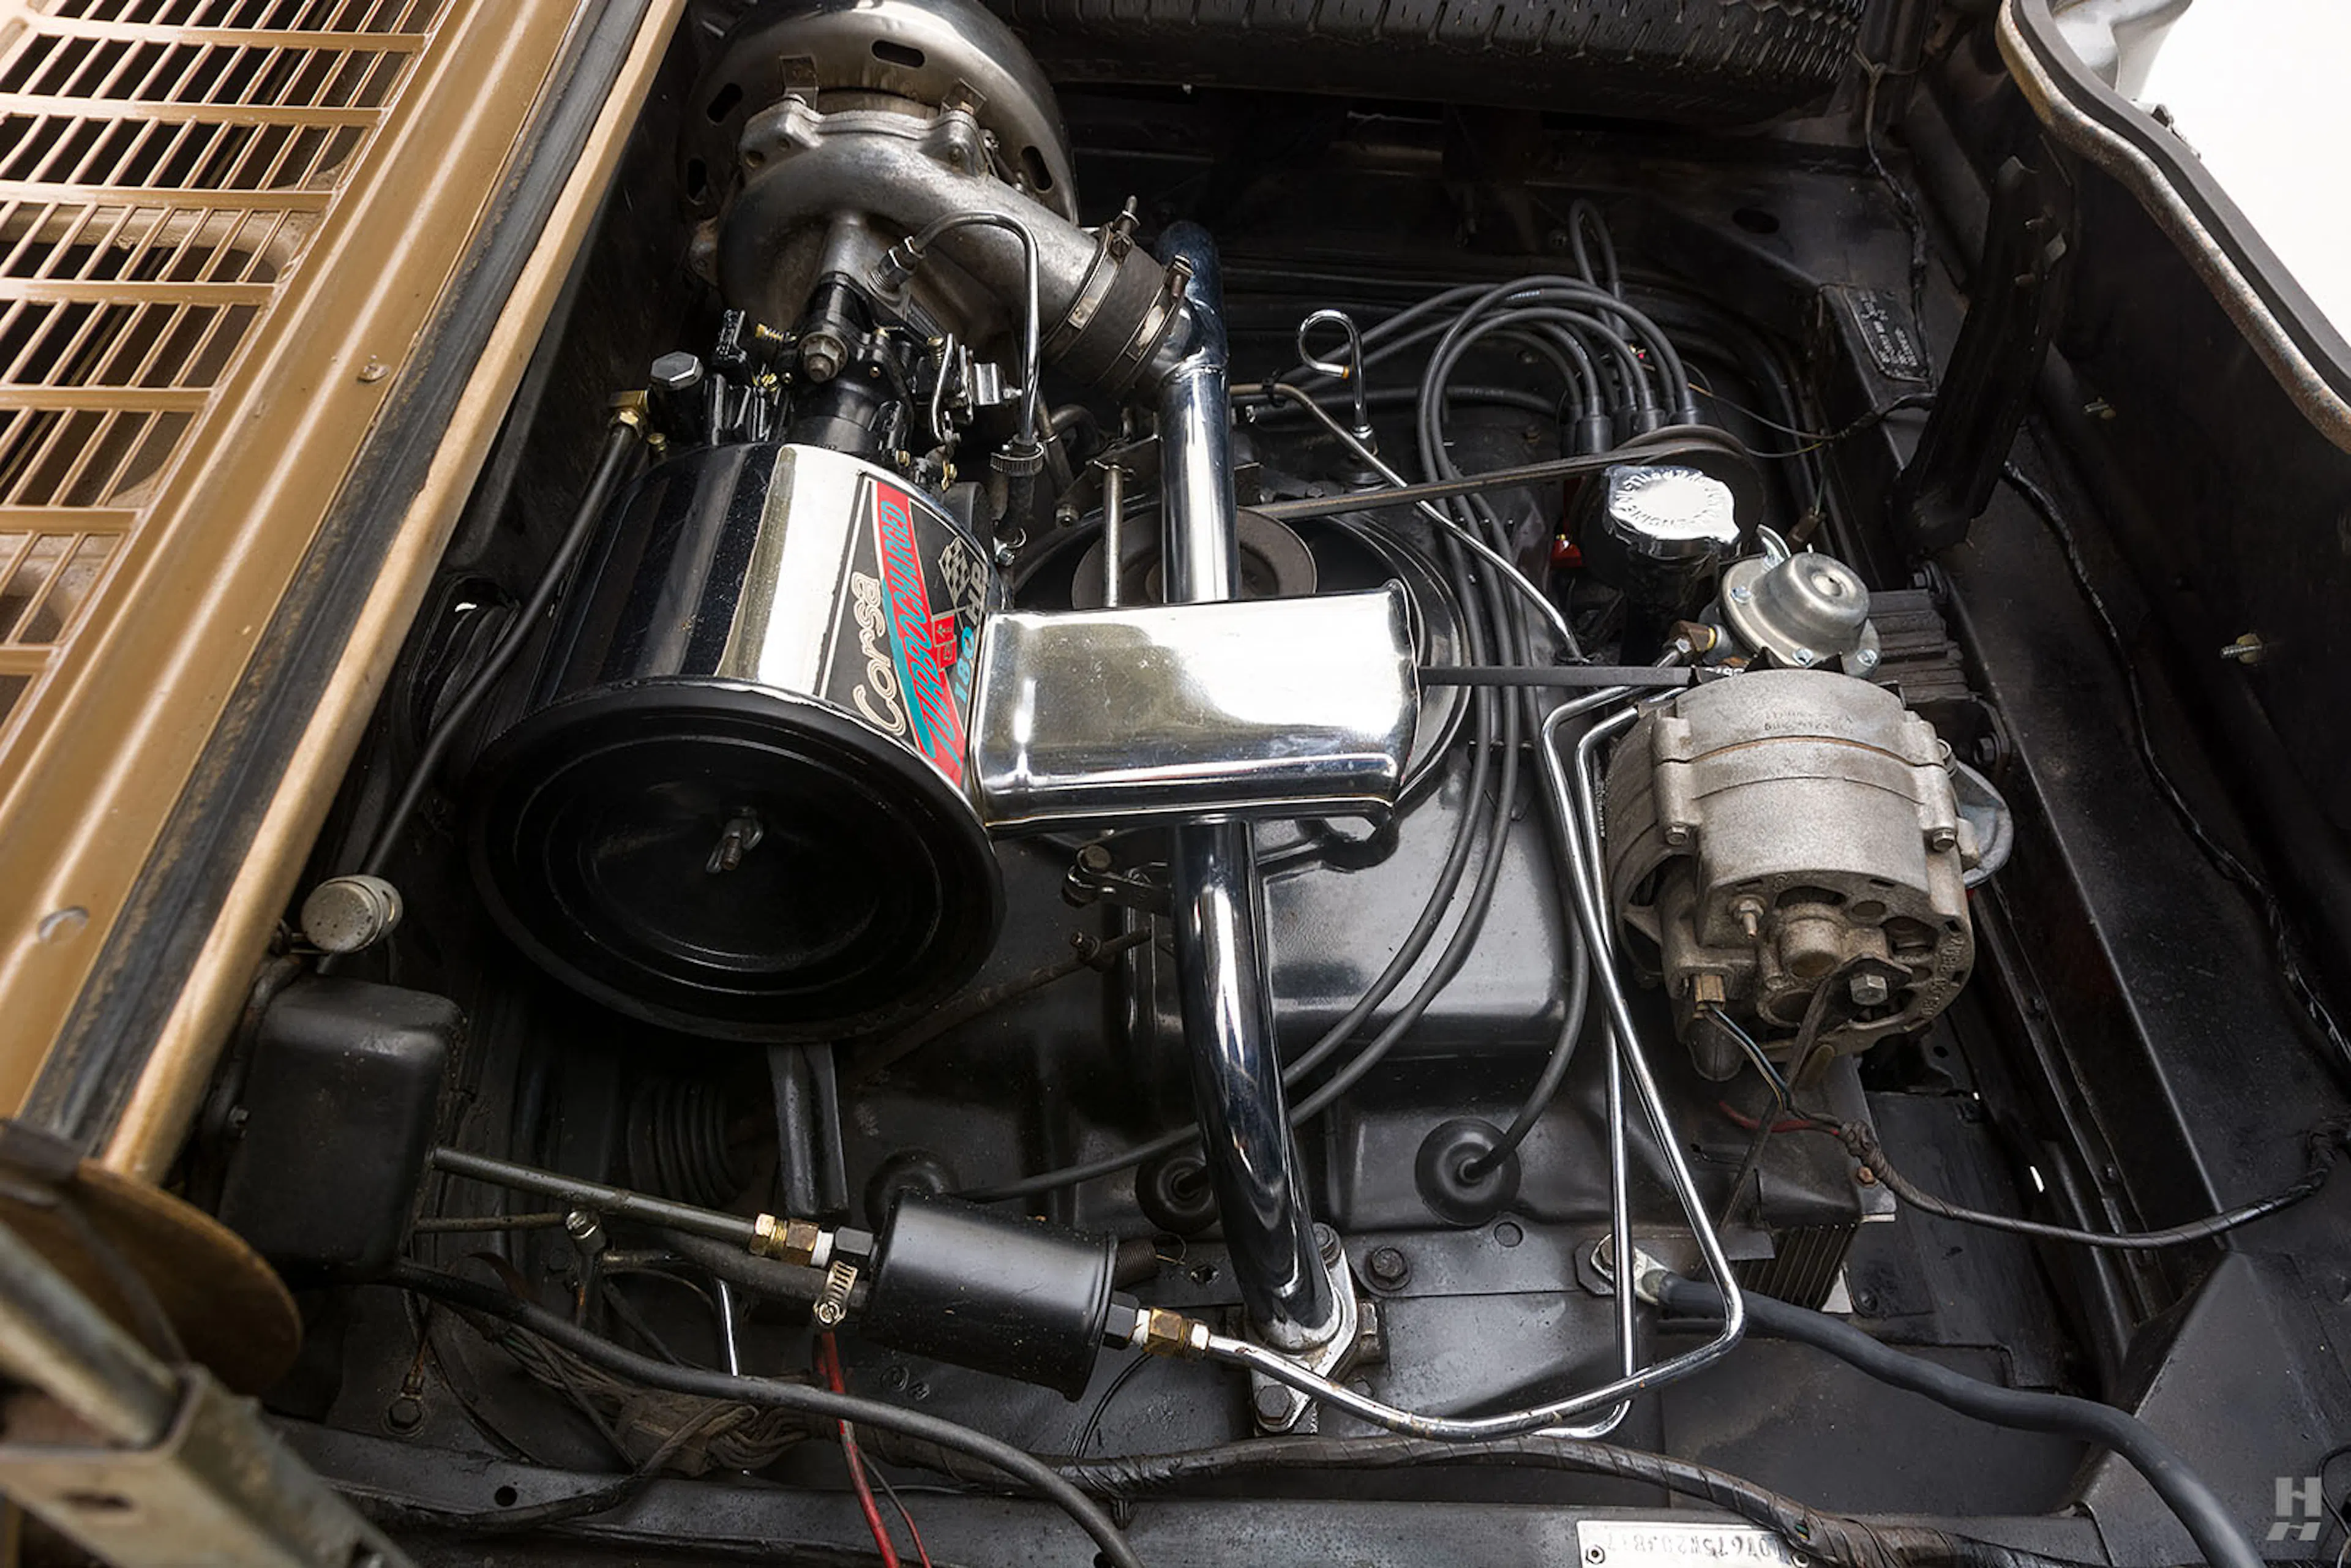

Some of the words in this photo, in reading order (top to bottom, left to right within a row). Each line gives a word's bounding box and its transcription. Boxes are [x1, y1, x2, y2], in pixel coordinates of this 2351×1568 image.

[881, 500, 963, 768] TURBOCHARGED
[965, 561, 988, 625] HP
[852, 572, 907, 737] Corsa
[954, 626, 977, 705] 180
